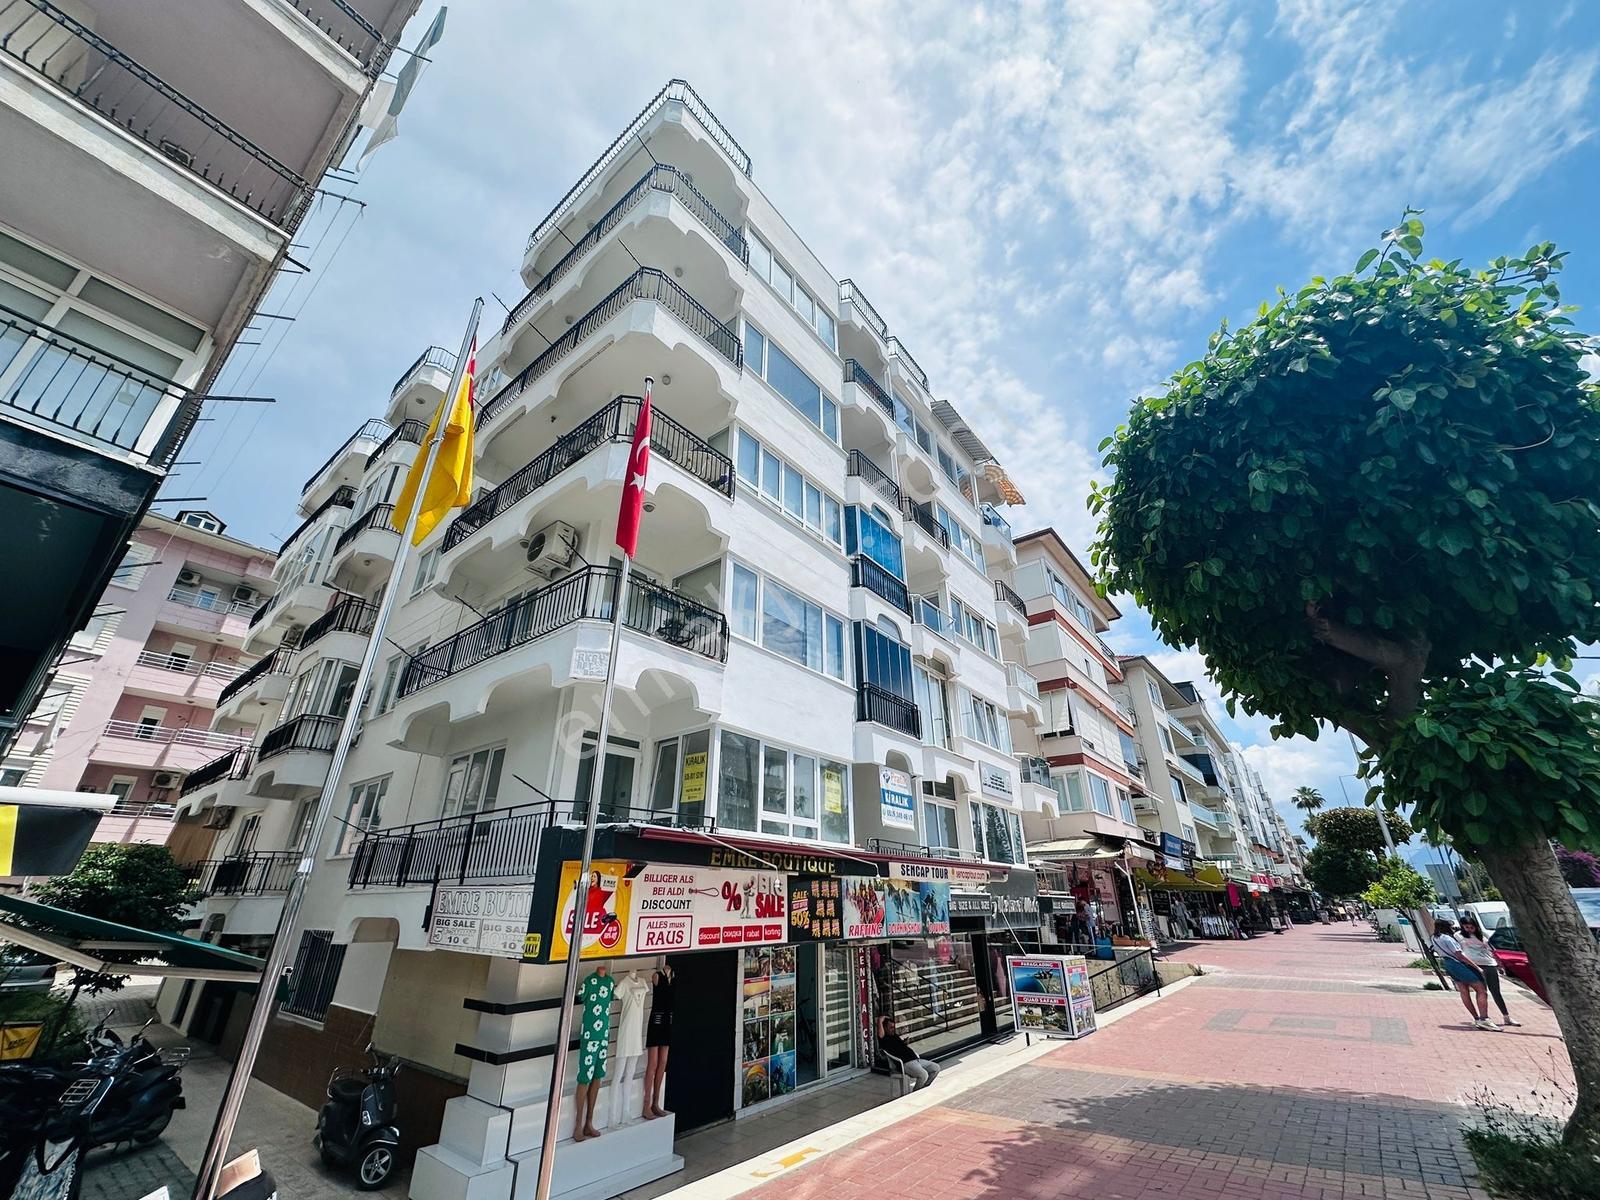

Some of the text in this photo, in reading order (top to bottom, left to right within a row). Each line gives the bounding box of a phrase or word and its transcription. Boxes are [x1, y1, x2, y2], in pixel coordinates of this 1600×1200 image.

[710, 847, 836, 873] EMRE BOUTIQUE
[901, 864, 949, 879] SENCAP TOUR
[644, 873, 694, 883] BILLIGER ALS
[757, 872, 784, 896] BIG
[652, 887, 685, 896] BEI ALDI
[721, 880, 742, 912] %
[792, 890, 808, 900] SALE
[435, 890, 481, 916] EMRE
[641, 899, 691, 910] DISCOUNT
[755, 892, 785, 919] SALE
[436, 918, 476, 929] BIG SALE
[567, 911, 601, 930] SLE
[647, 920, 668, 930] ALLES
[791, 911, 810, 928] 50%
[483, 923, 502, 932] BIG
[764, 927, 782, 938] korting
[848, 922, 884, 937] RAFTING
[433, 927, 444, 942] 5
[646, 930, 684, 946] RAUS
[700, 931, 721, 941] discount
[723, 929, 742, 939] скидка
[746, 929, 760, 938] rabat
[447, 936, 460, 944] 10
[501, 941, 517, 950] 10
[858, 946, 867, 989] RENT
[1040, 997, 1060, 1005] SAFARI
[862, 1003, 867, 1013] A
